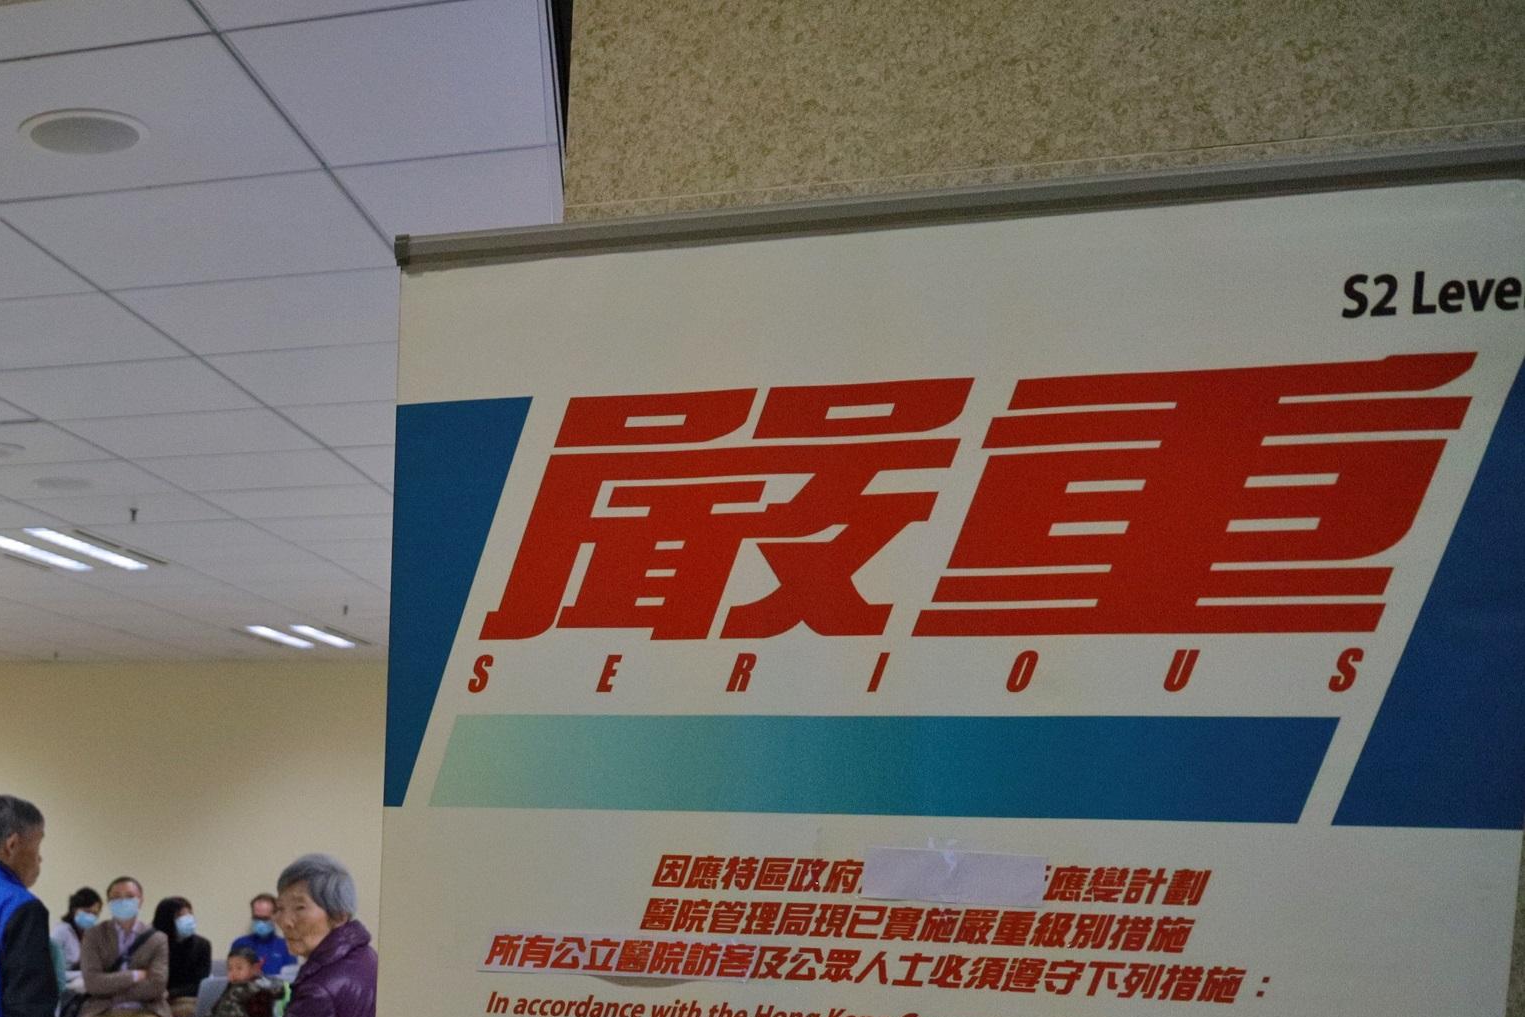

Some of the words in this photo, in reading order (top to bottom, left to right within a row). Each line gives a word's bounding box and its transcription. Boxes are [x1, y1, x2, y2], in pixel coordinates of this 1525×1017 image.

[1342, 274, 1398, 319] S2
[1412, 270, 1525, 315] Leve
[479, 350, 1478, 641] 嚴重
[468, 647, 1365, 695] SERIOUS
[486, 992, 509, 1014] In
